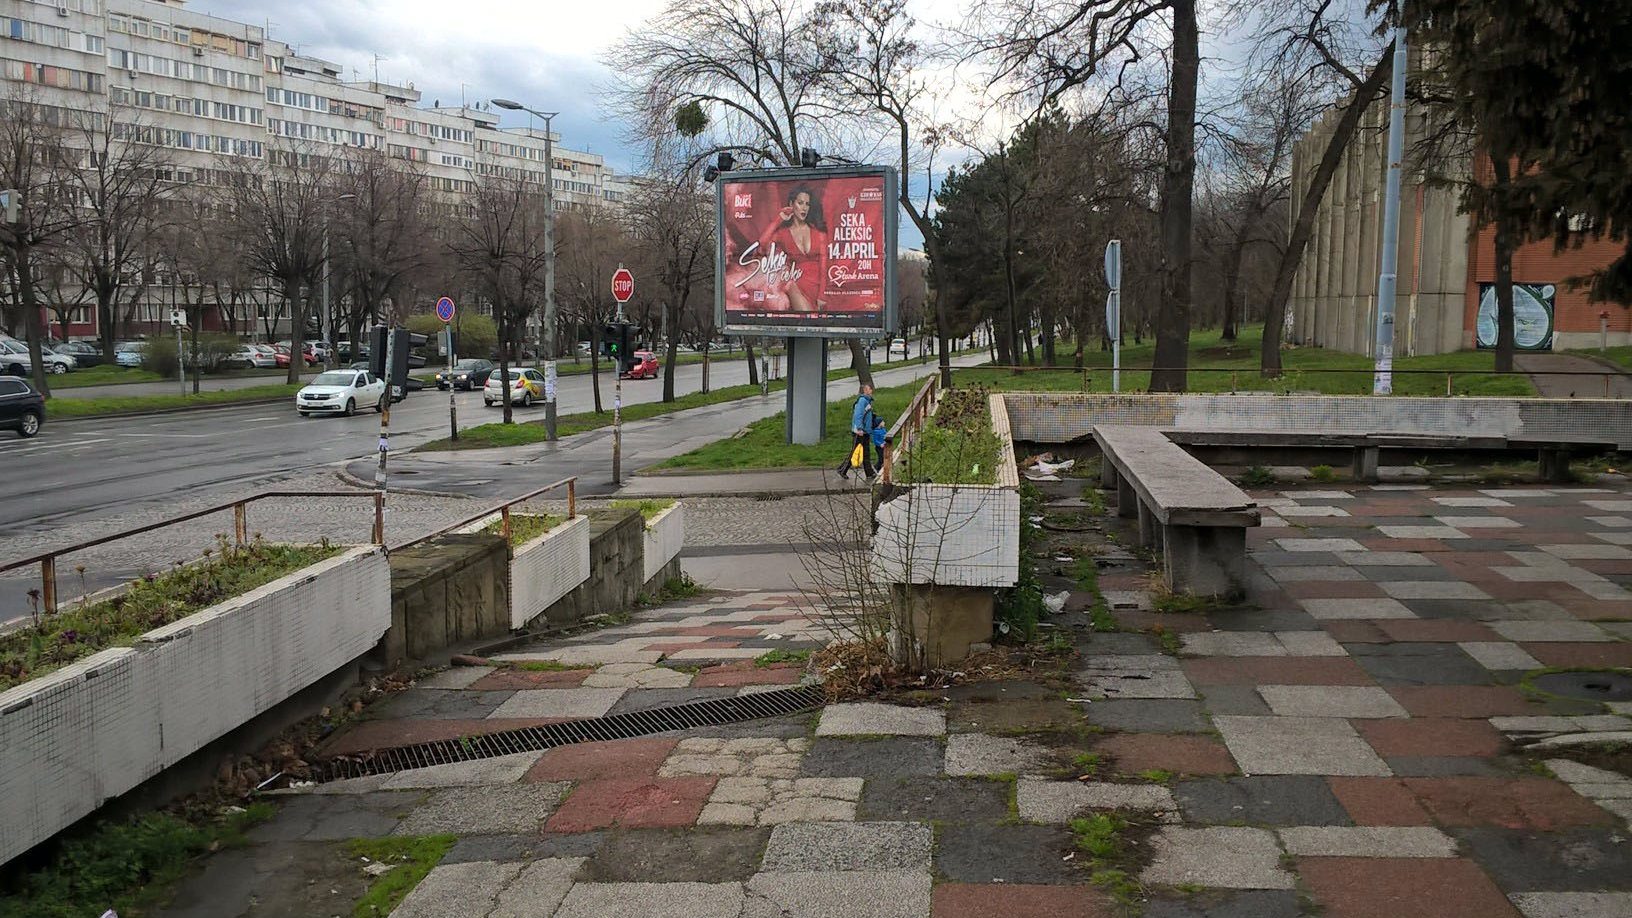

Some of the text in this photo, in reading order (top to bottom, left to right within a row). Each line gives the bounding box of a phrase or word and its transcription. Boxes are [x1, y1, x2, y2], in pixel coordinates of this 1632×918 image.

[840, 213, 866, 228] SEKA
[833, 224, 873, 241] ALEKSIĆ
[735, 241, 787, 288] Seka
[857, 260, 872, 270] 20H
[857, 272, 879, 280] Arena
[614, 280, 632, 292] STOP
